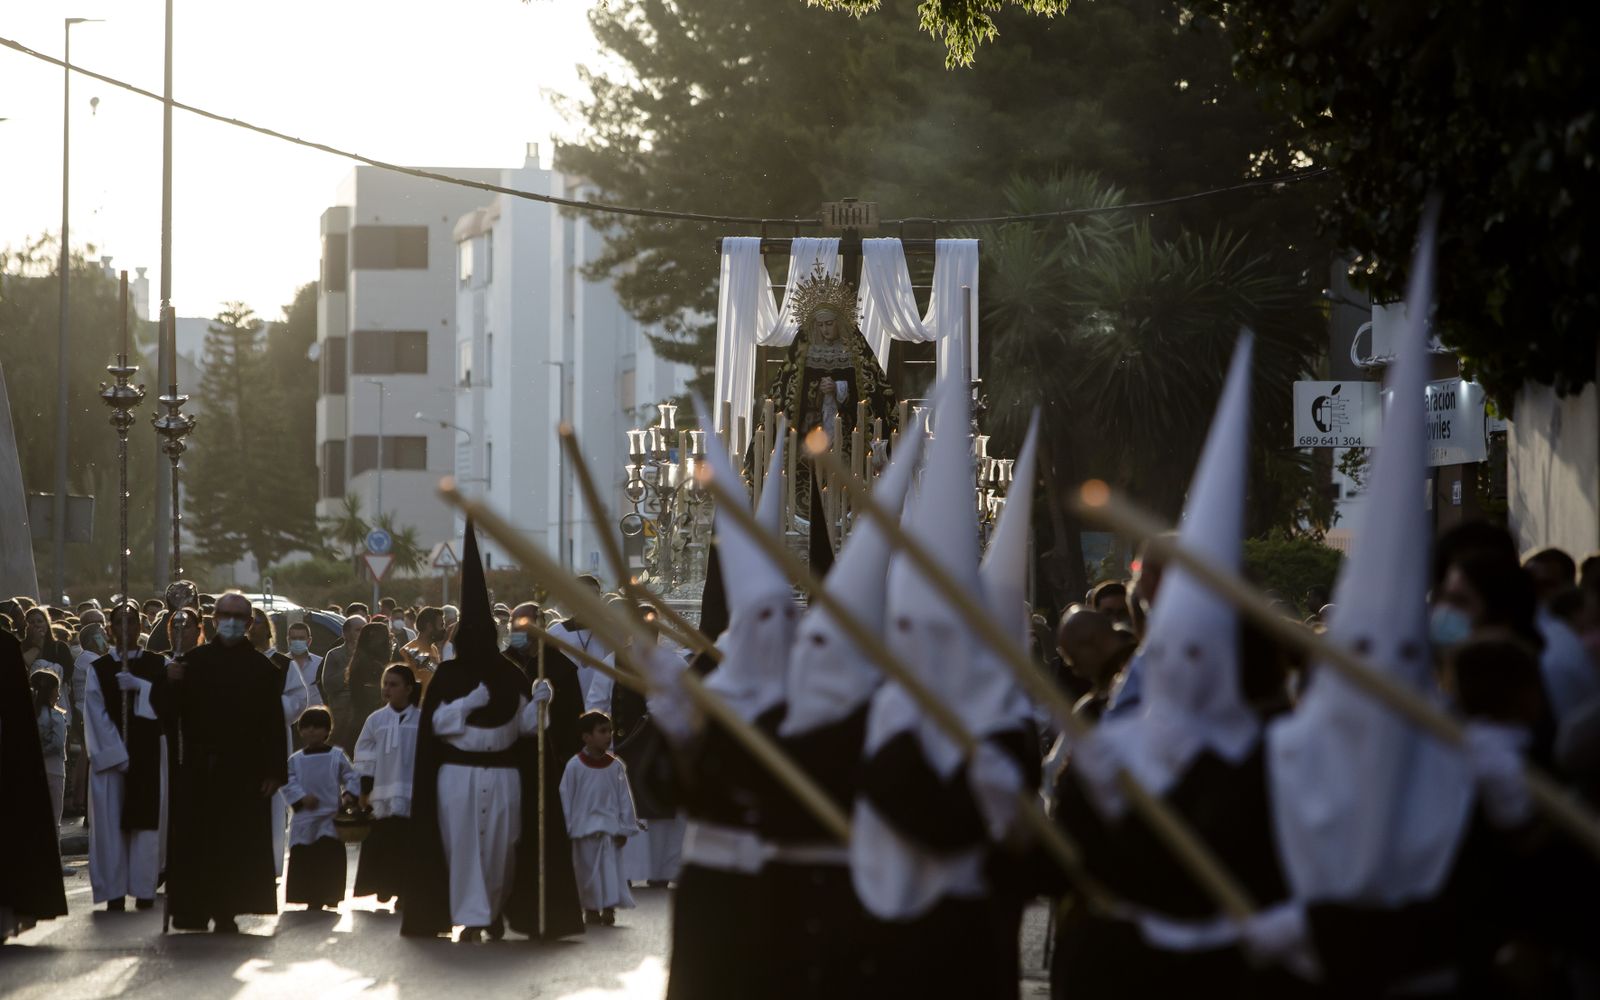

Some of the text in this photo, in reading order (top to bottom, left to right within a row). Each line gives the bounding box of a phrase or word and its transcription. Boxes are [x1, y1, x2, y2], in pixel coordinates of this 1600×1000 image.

[831, 204, 869, 225] INRI
[1425, 384, 1456, 412] aración
[1426, 413, 1451, 440] óviles
[1299, 436, 1361, 446] 689 641 304
